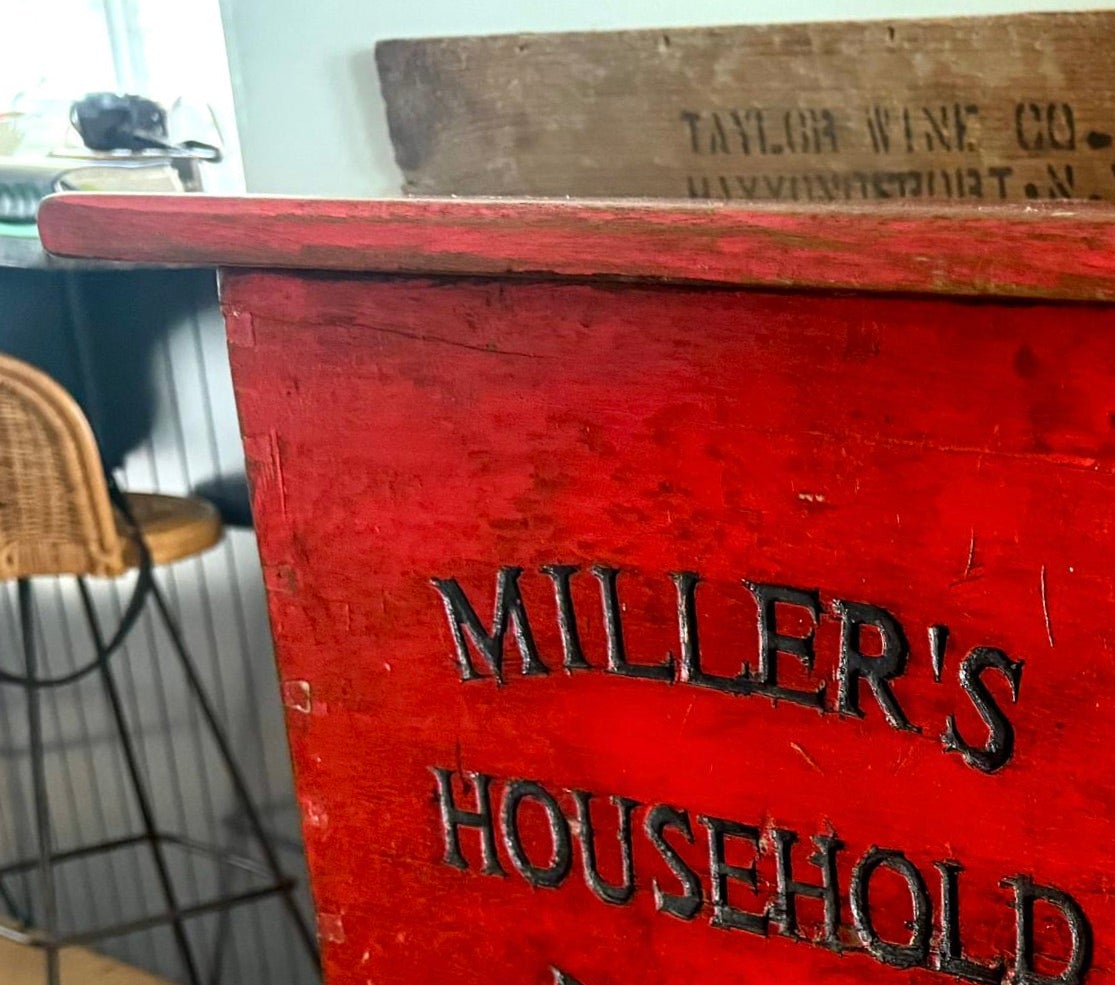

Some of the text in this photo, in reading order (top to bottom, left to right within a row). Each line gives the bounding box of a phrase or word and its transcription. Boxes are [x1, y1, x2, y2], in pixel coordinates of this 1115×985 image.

[682, 108, 838, 156] TAYLOR
[866, 103, 979, 153] WINE
[430, 564, 1025, 774] MILLER'S
